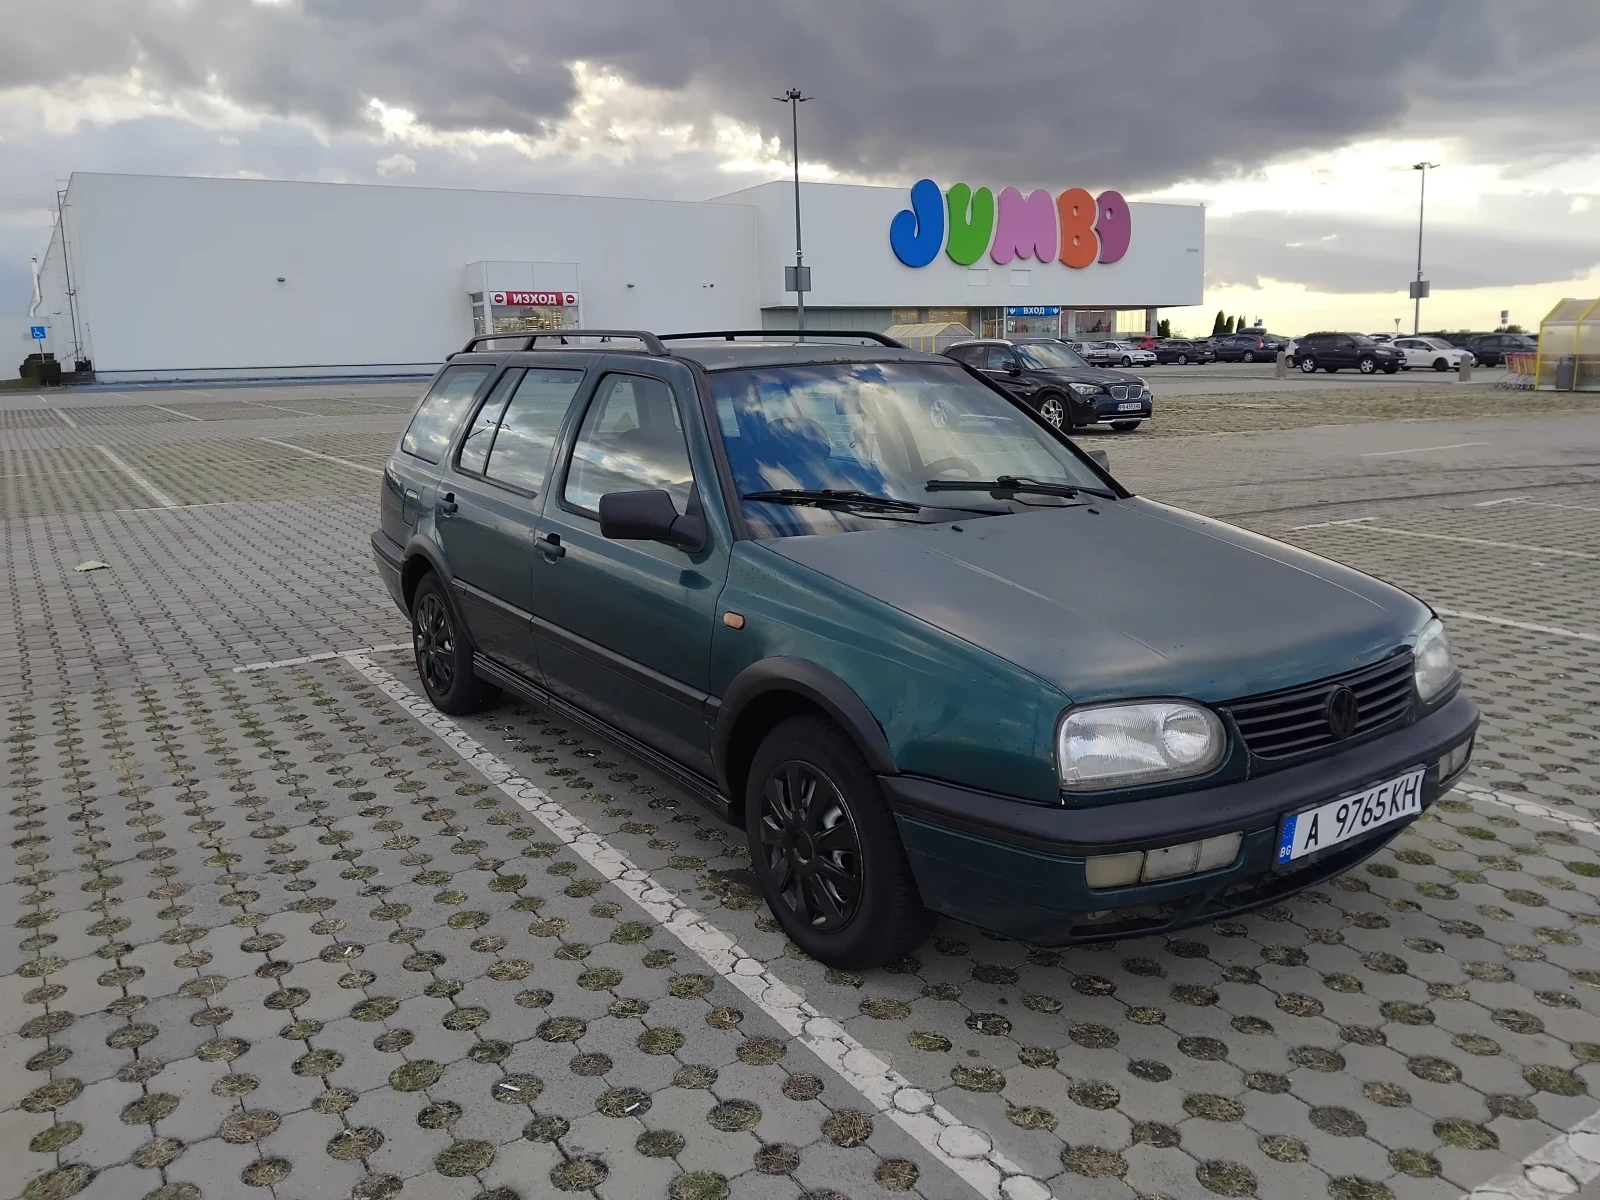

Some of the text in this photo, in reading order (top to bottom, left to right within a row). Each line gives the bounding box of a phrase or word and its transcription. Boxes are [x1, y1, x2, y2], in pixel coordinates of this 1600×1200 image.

[890, 179, 1132, 268] JUMBO
[513, 293, 557, 305] ИЗХОД
[1023, 306, 1045, 315] ВХОД
[1304, 812, 1319, 850] A
[1279, 845, 1292, 858] BG
